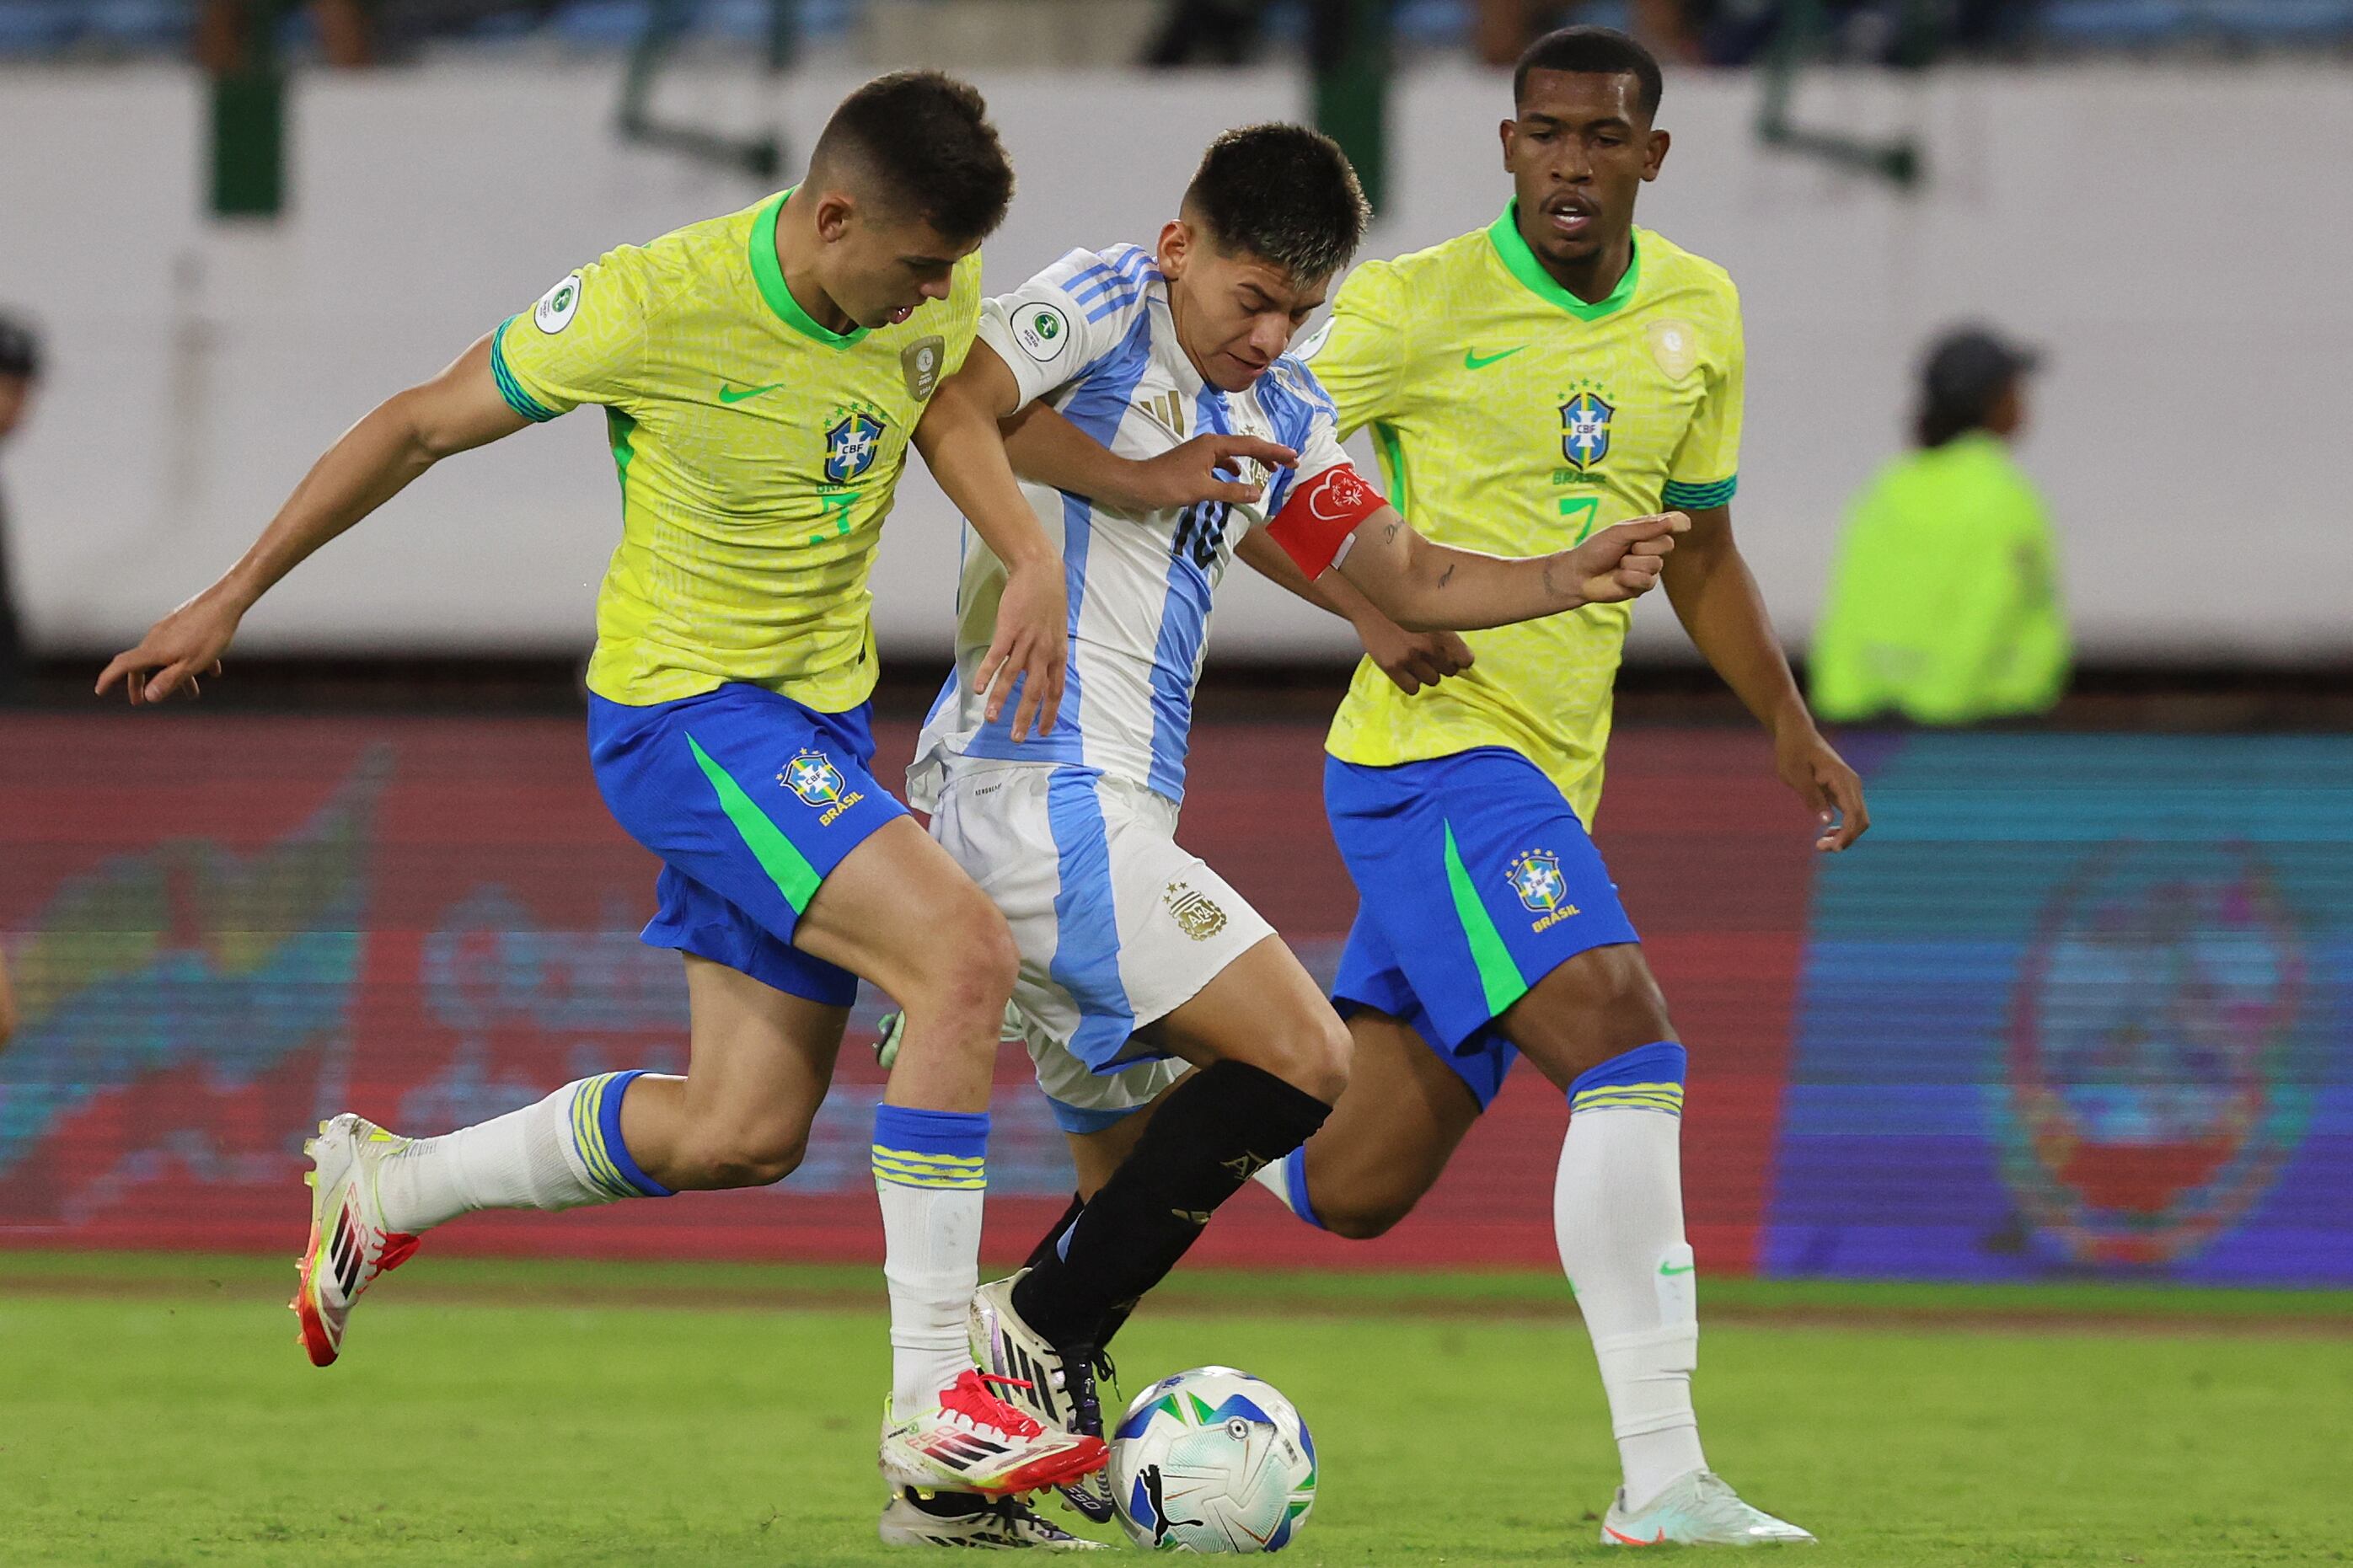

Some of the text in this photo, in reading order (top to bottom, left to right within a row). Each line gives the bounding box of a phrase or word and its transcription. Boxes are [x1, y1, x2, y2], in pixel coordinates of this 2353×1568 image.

[1576, 424, 1596, 434] CBF
[842, 443, 864, 454] CBF
[1174, 500, 1232, 570] 10
[1560, 497, 1598, 547] 7
[805, 771, 823, 785] CBF
[818, 792, 865, 827] BRASIL
[1531, 904, 1581, 933] BRASIL
